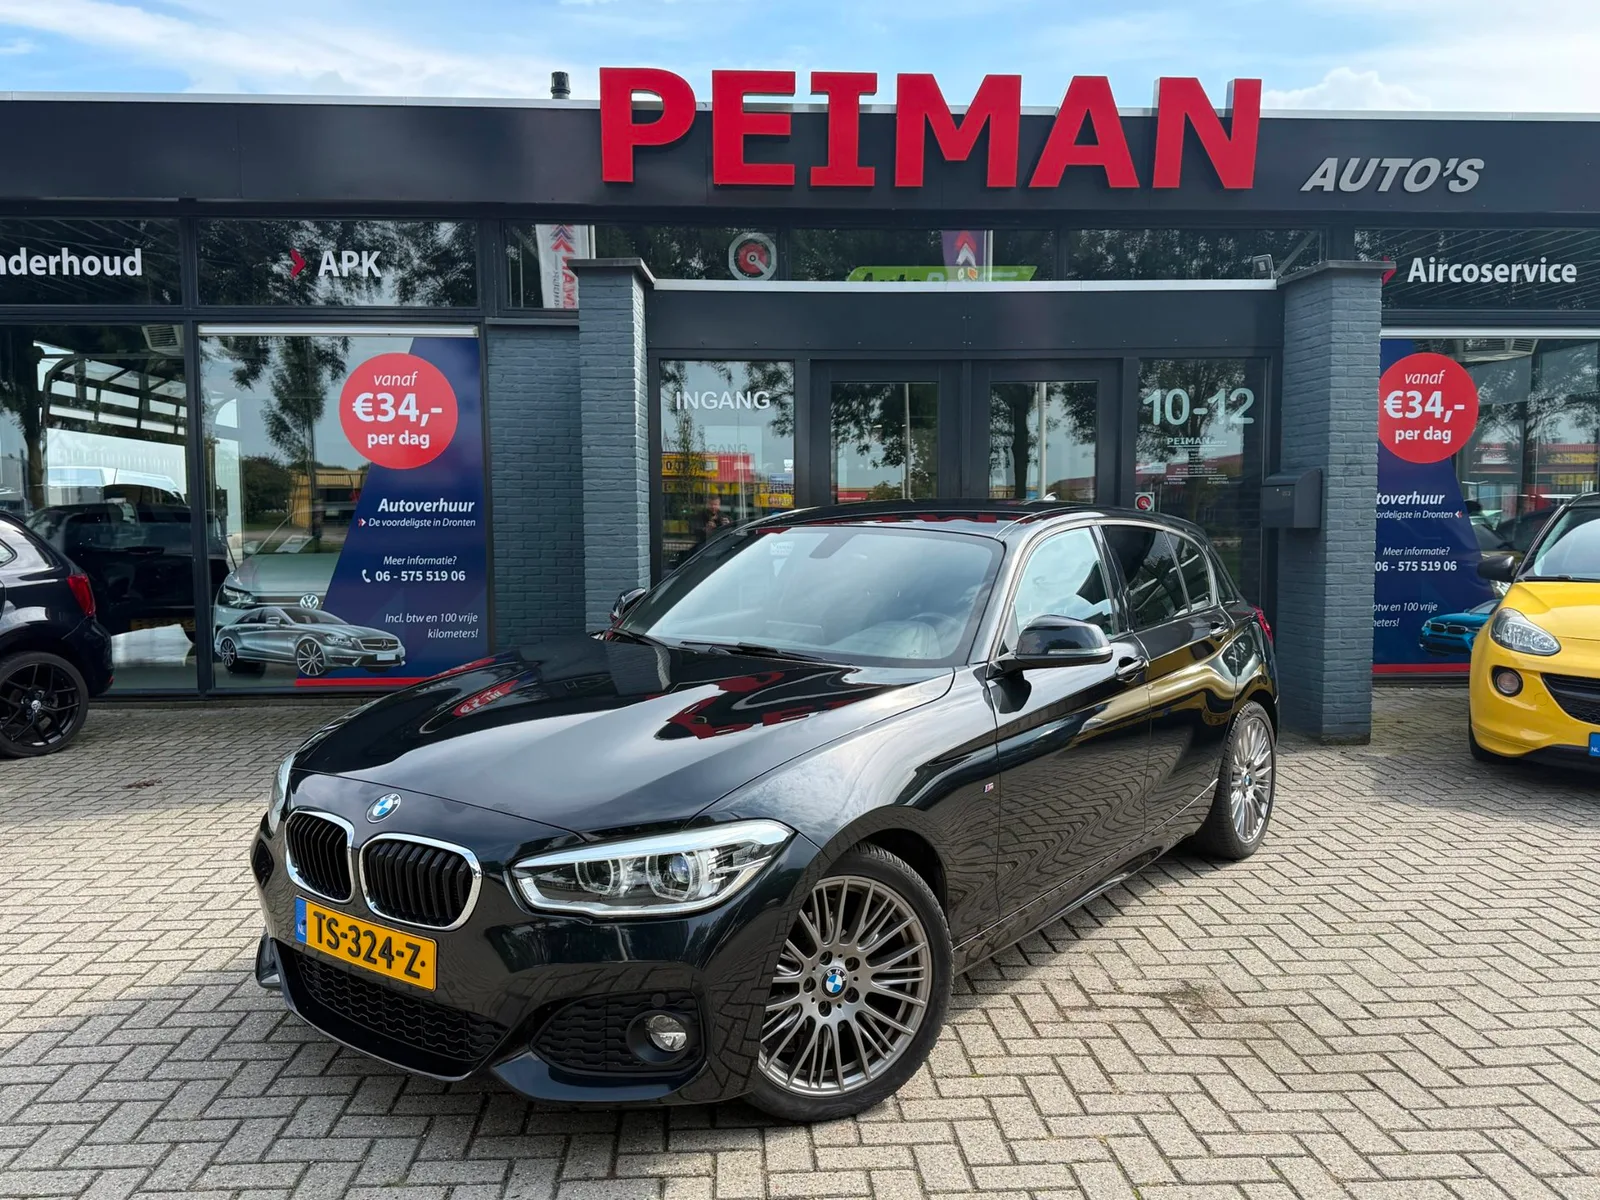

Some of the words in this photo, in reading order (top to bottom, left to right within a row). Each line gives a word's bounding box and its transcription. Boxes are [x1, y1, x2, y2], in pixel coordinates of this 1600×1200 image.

[599, 66, 1262, 189] PEIMAN
[1300, 157, 1485, 193] AUTO'S
[317, 250, 381, 277] APK
[1407, 256, 1577, 283] Aircoservice
[373, 371, 419, 386] vanaf
[1404, 370, 1446, 385] vanaf
[676, 391, 770, 410] INGANG
[1143, 387, 1255, 426] 10-12
[1384, 390, 1465, 422] €34,-
[352, 392, 443, 427] €34,-
[367, 433, 395, 449] per
[399, 430, 430, 449] dag
[1166, 436, 1210, 445] PEIMAN
[1395, 428, 1420, 443] per
[1423, 426, 1452, 443] dag
[377, 498, 475, 512] Autoverhuur
[1413, 510, 1421, 519] in
[1422, 510, 1453, 519] Dronten
[368, 517, 381, 527] De
[381, 517, 432, 529] voordeligste
[433, 517, 441, 527] in
[442, 517, 476, 527] Dronten
[1382, 546, 1403, 556] Meer
[1404, 546, 1450, 556] informatie?
[383, 555, 406, 565] Meer
[407, 555, 457, 566] informatie?
[1375, 561, 1389, 571] 06
[1397, 561, 1418, 571] 575
[1420, 561, 1441, 571] 519
[1443, 560, 1457, 571] 06
[375, 570, 391, 582] 06
[400, 570, 423, 582] 575
[426, 570, 448, 582] 519
[450, 570, 466, 582] 06
[1390, 603, 1401, 611] en
[1403, 602, 1419, 611] 100
[1420, 601, 1438, 613] vrije
[385, 612, 404, 623] Incl.
[406, 612, 424, 623] btw
[426, 615, 438, 623] en
[440, 612, 457, 623] 100
[458, 612, 478, 625] vrije
[427, 628, 479, 639] kilometers!
[313, 910, 422, 979] TS-324-Z
